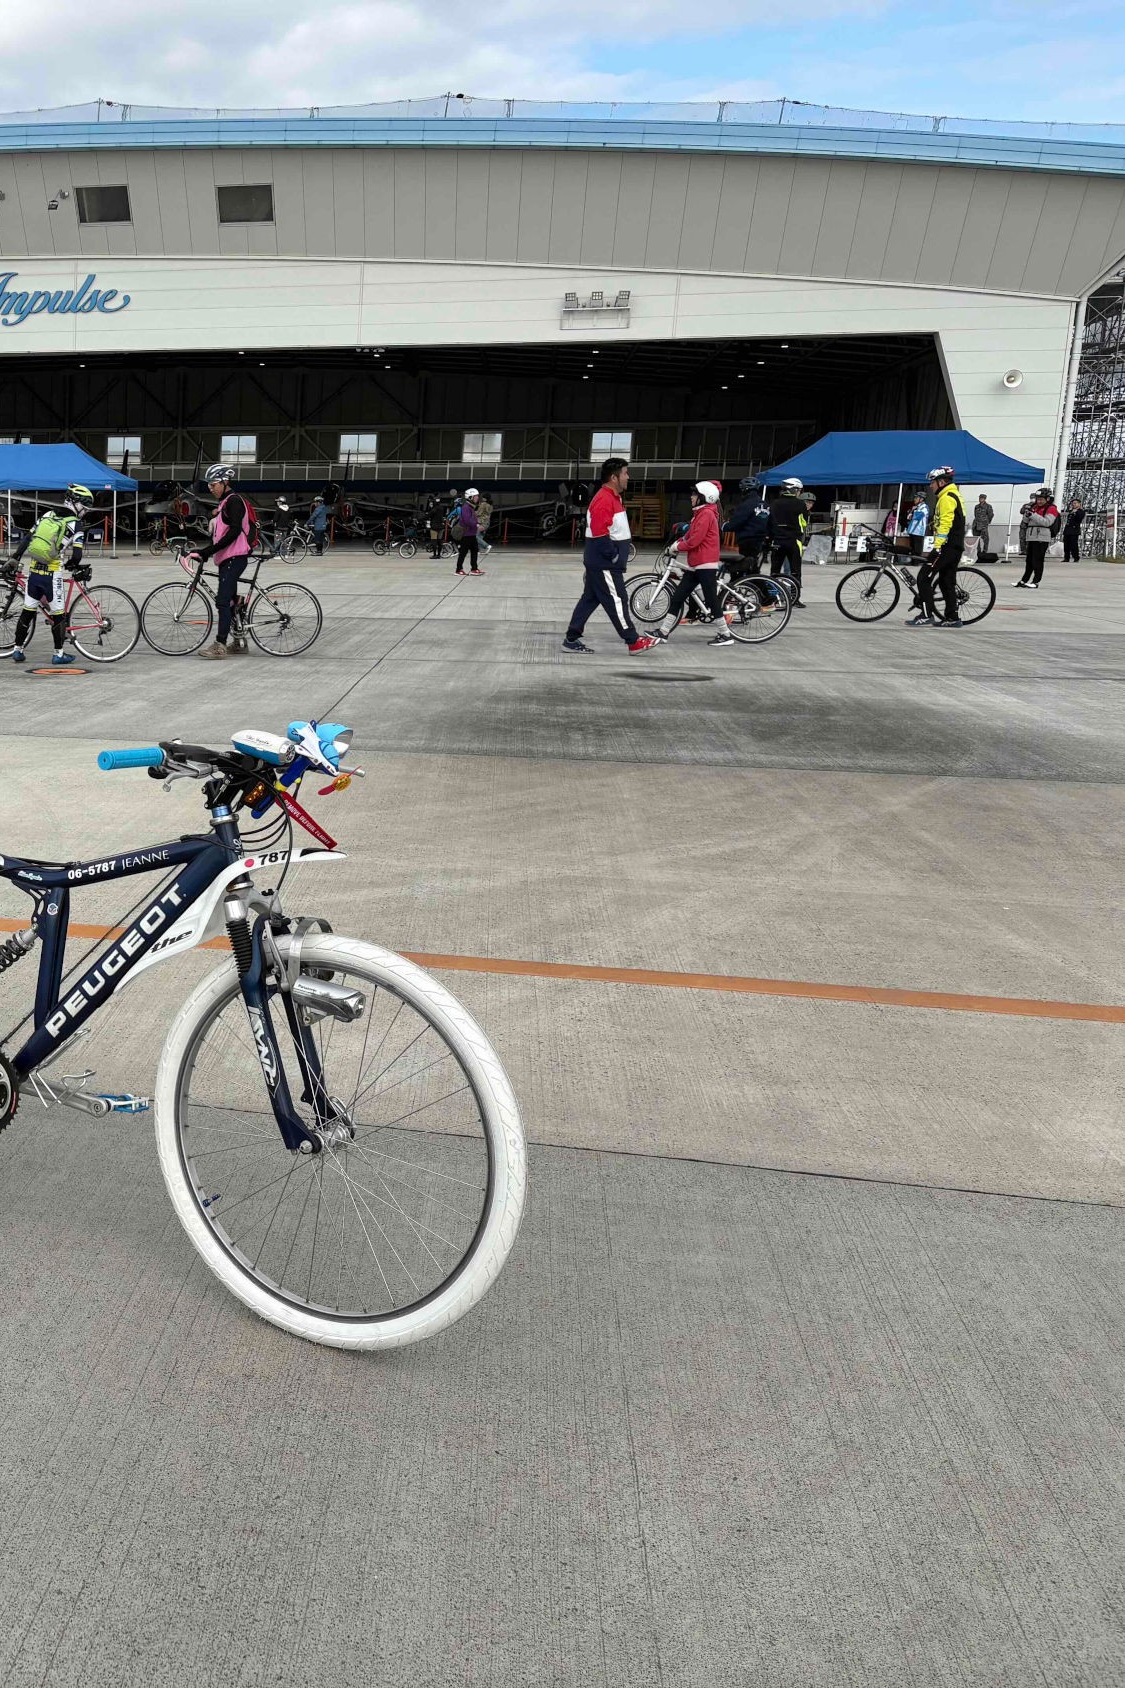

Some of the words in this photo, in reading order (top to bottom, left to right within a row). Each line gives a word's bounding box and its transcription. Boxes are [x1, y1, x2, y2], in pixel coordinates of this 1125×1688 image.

[67, 860, 117, 879] 06-5787
[121, 849, 170, 870] JEANNE
[258, 850, 289, 866] 787
[150, 930, 193, 954] the
[45, 883, 182, 1038] PEUGEOT
